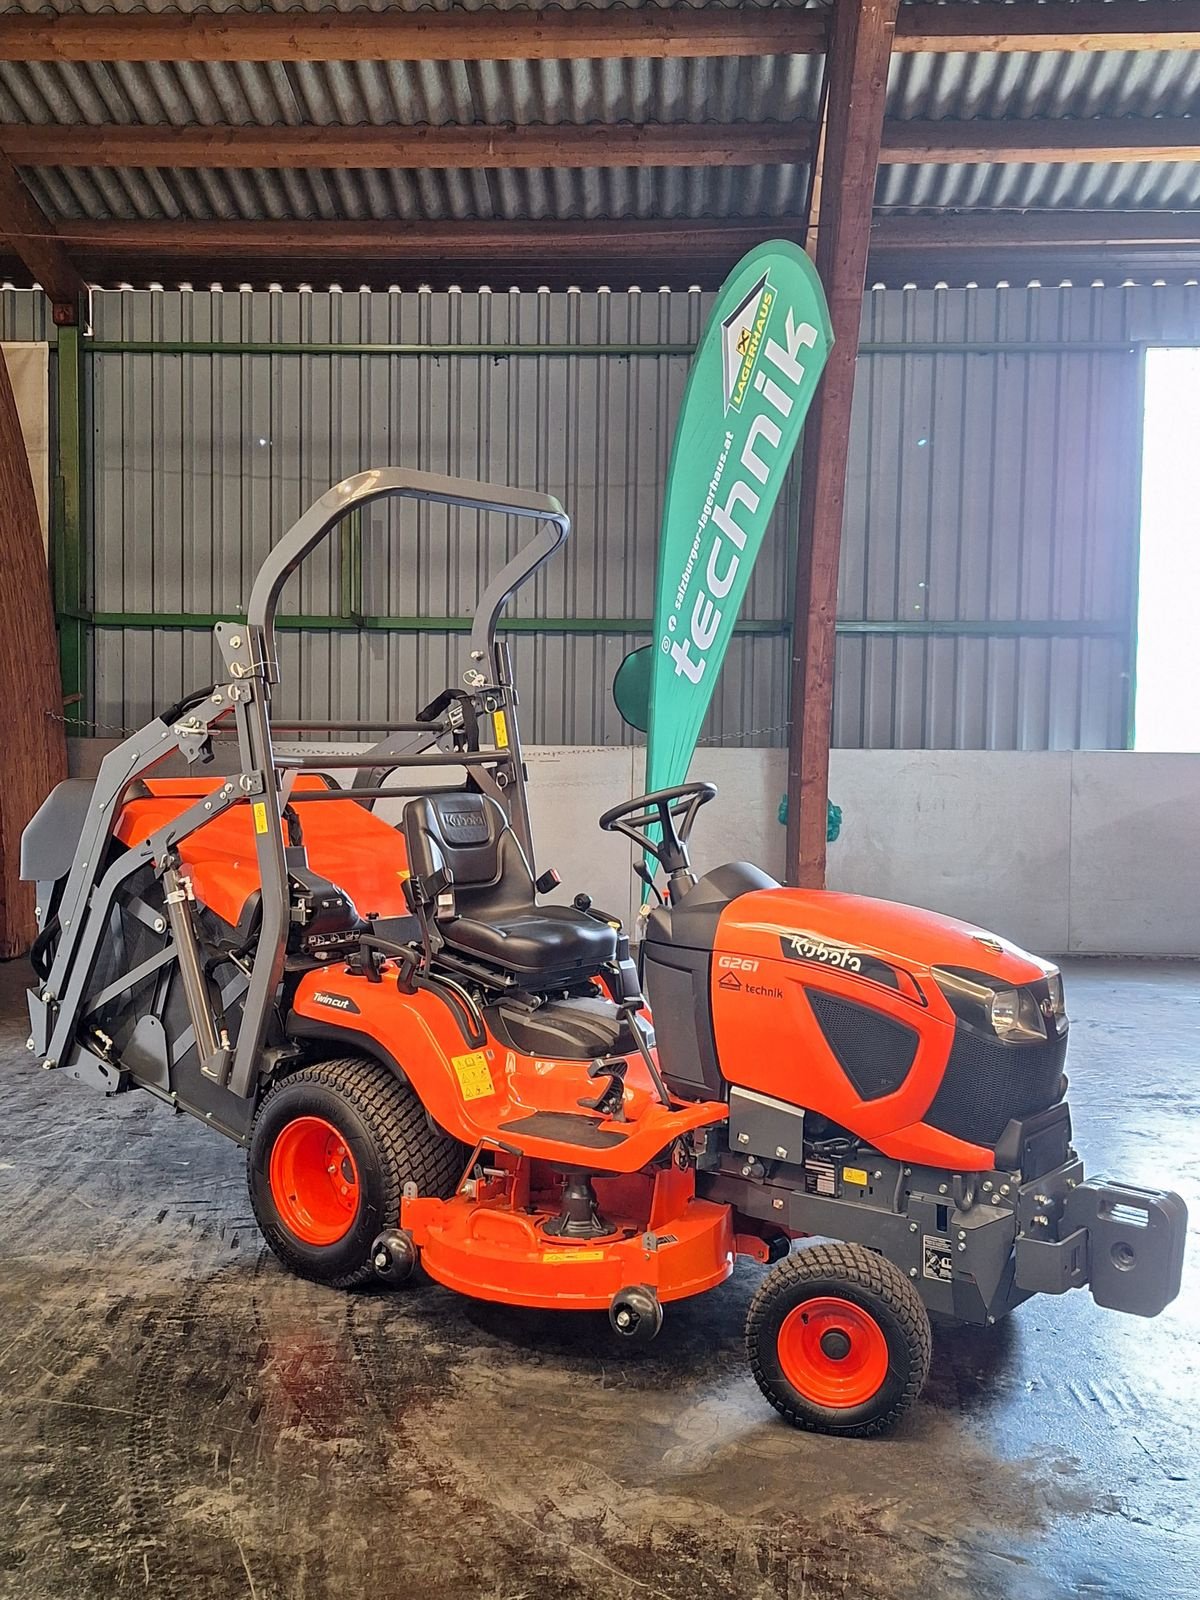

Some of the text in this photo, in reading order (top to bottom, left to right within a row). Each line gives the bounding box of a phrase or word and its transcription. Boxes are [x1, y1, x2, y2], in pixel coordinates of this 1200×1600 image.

[733, 292, 772, 404] LAGERHAUS
[669, 305, 818, 685] technik
[675, 431, 734, 610] salzburger-lagerhaus.at
[443, 813, 484, 827] Kubota
[718, 956, 759, 972] G261
[791, 935, 861, 972] Kubota
[313, 992, 349, 1009] Twincut
[745, 983, 783, 999] technik
